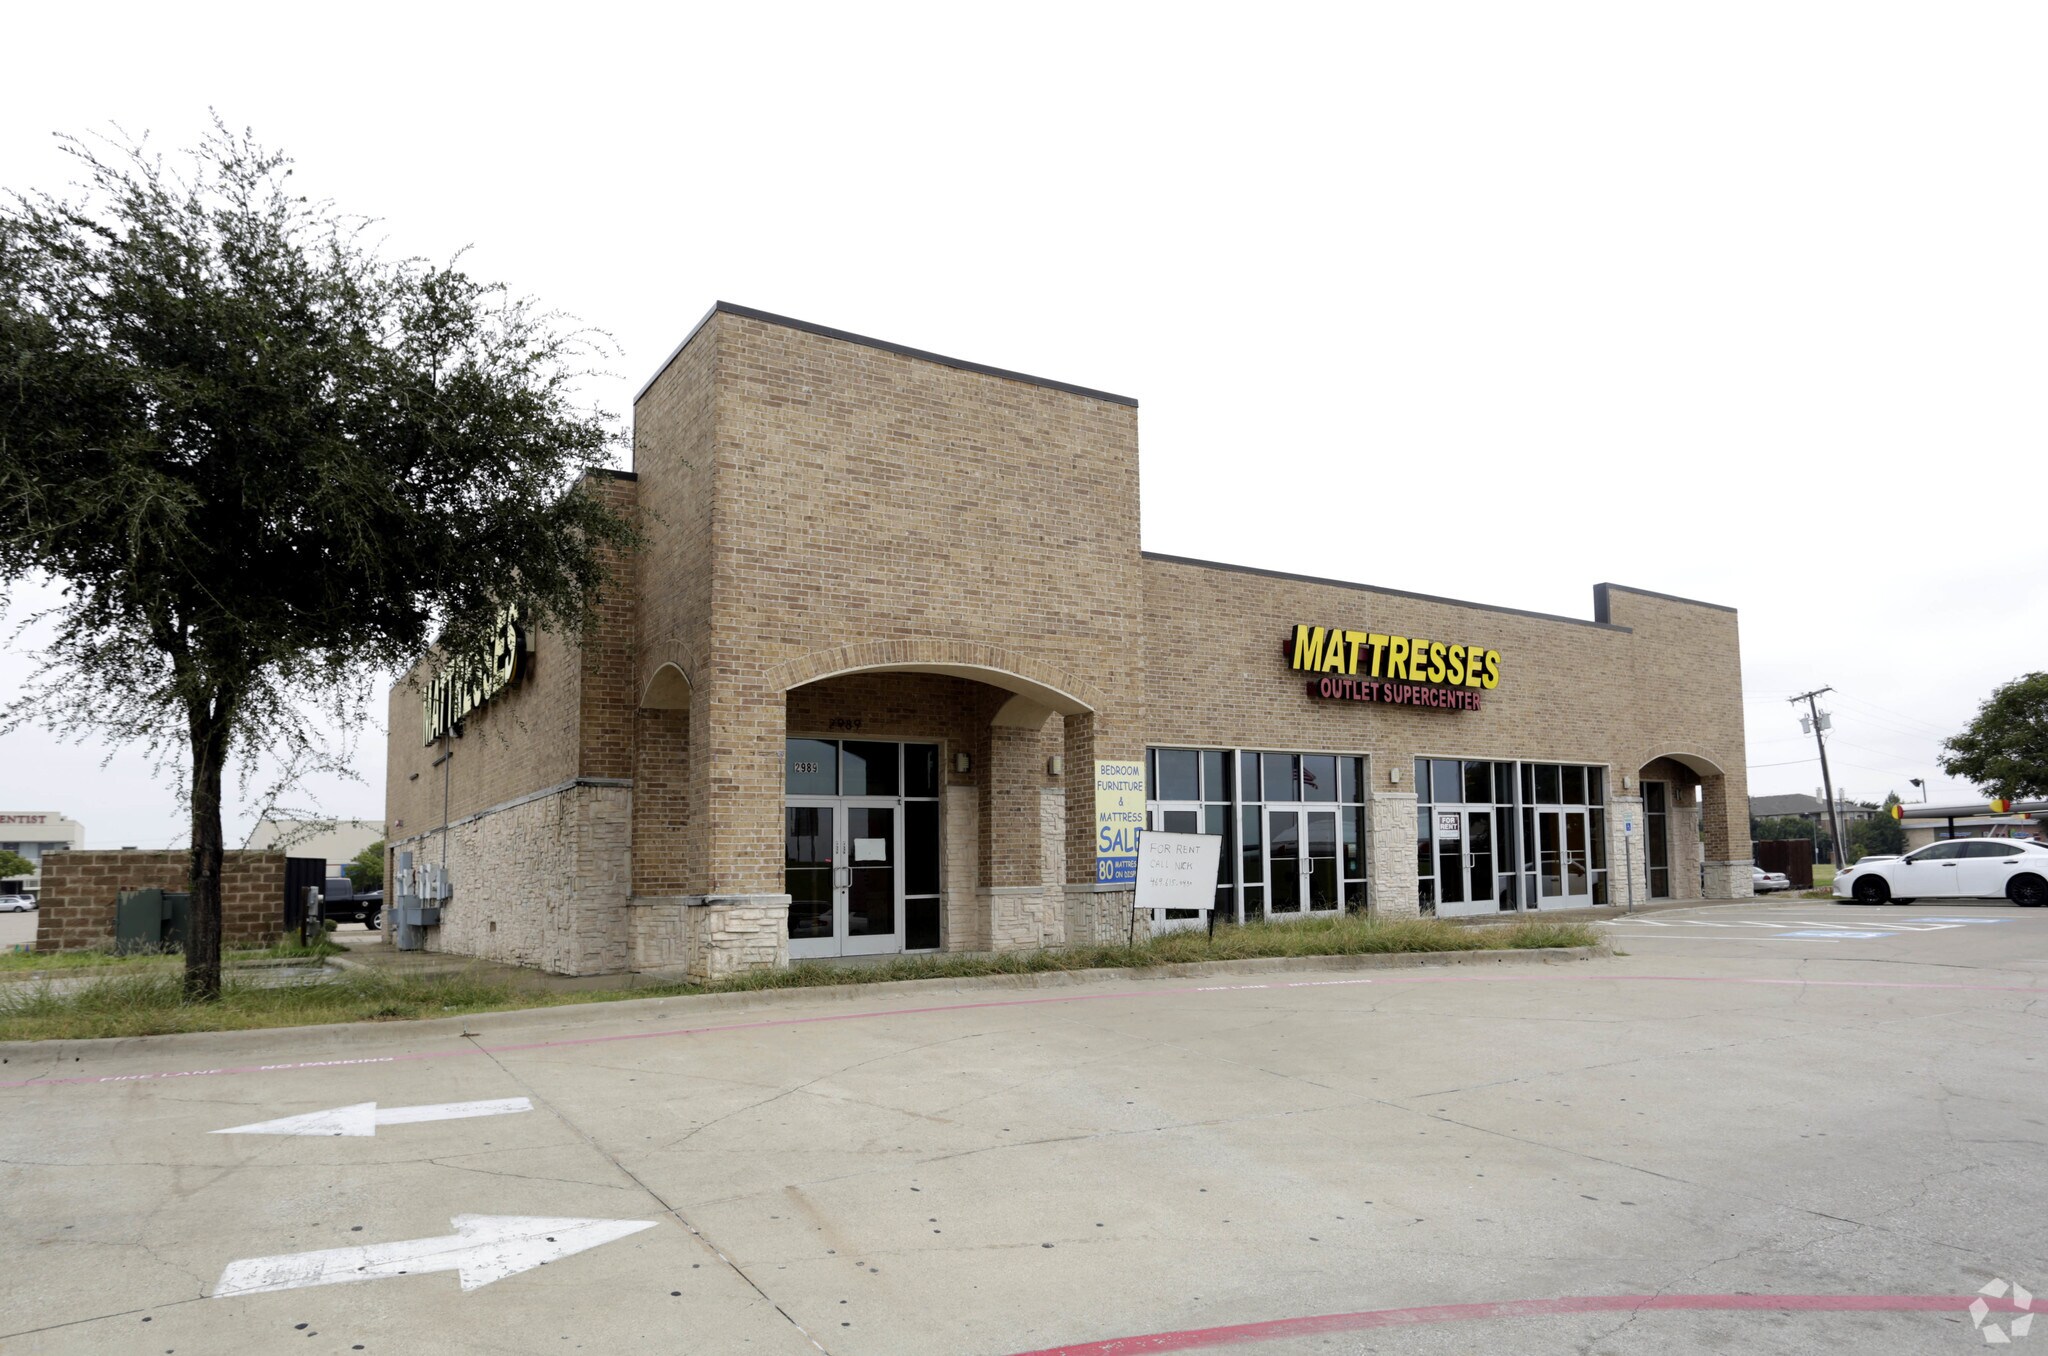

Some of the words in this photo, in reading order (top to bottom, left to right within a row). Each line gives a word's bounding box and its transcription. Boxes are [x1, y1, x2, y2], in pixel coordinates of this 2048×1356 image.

[1292, 624, 1502, 690] MATTRESSES
[1320, 677, 1379, 701] OUTLET
[1383, 683, 1482, 711] SUPERCENTER
[829, 718, 862, 730] 2989
[795, 762, 818, 773] 2989
[1100, 765, 1139, 776] BEDROOM
[1097, 780, 1143, 791] FURNITURE
[1118, 796, 1124, 806] &
[1100, 812, 1143, 822] MATTRESS
[1150, 843, 1171, 854] FOR
[1176, 845, 1201, 854] RENT
[1150, 859, 1169, 868] CALL
[1099, 860, 1114, 880] 80
[99, 1074, 155, 1082] FIRE
[161, 1069, 222, 1078] LANE
[298, 1056, 394, 1067] PARKING
